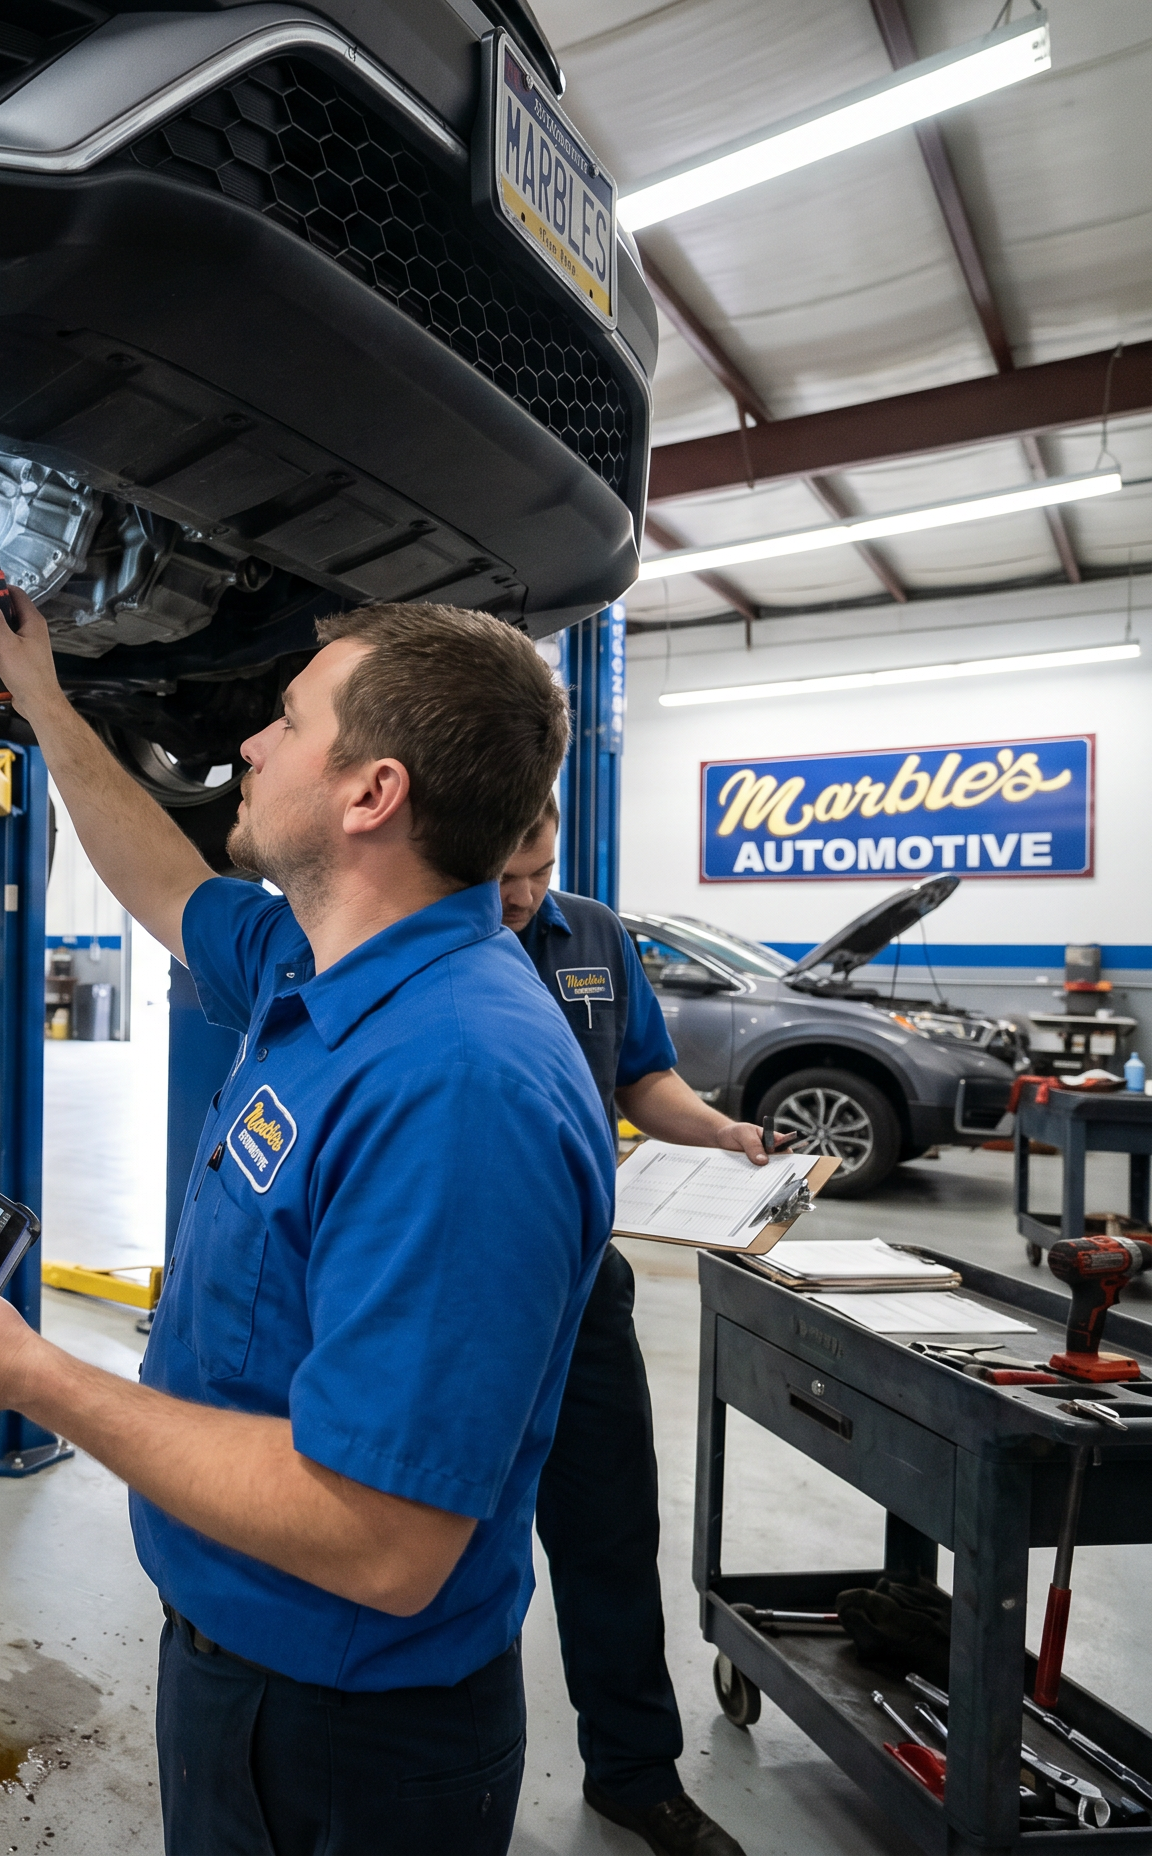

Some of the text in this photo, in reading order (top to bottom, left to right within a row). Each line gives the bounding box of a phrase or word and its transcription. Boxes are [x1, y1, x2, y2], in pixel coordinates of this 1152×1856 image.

[506, 95, 607, 282] MARBLES
[716, 748, 1072, 837] Marble's
[733, 832, 1053, 873] AUTOMOTIVE
